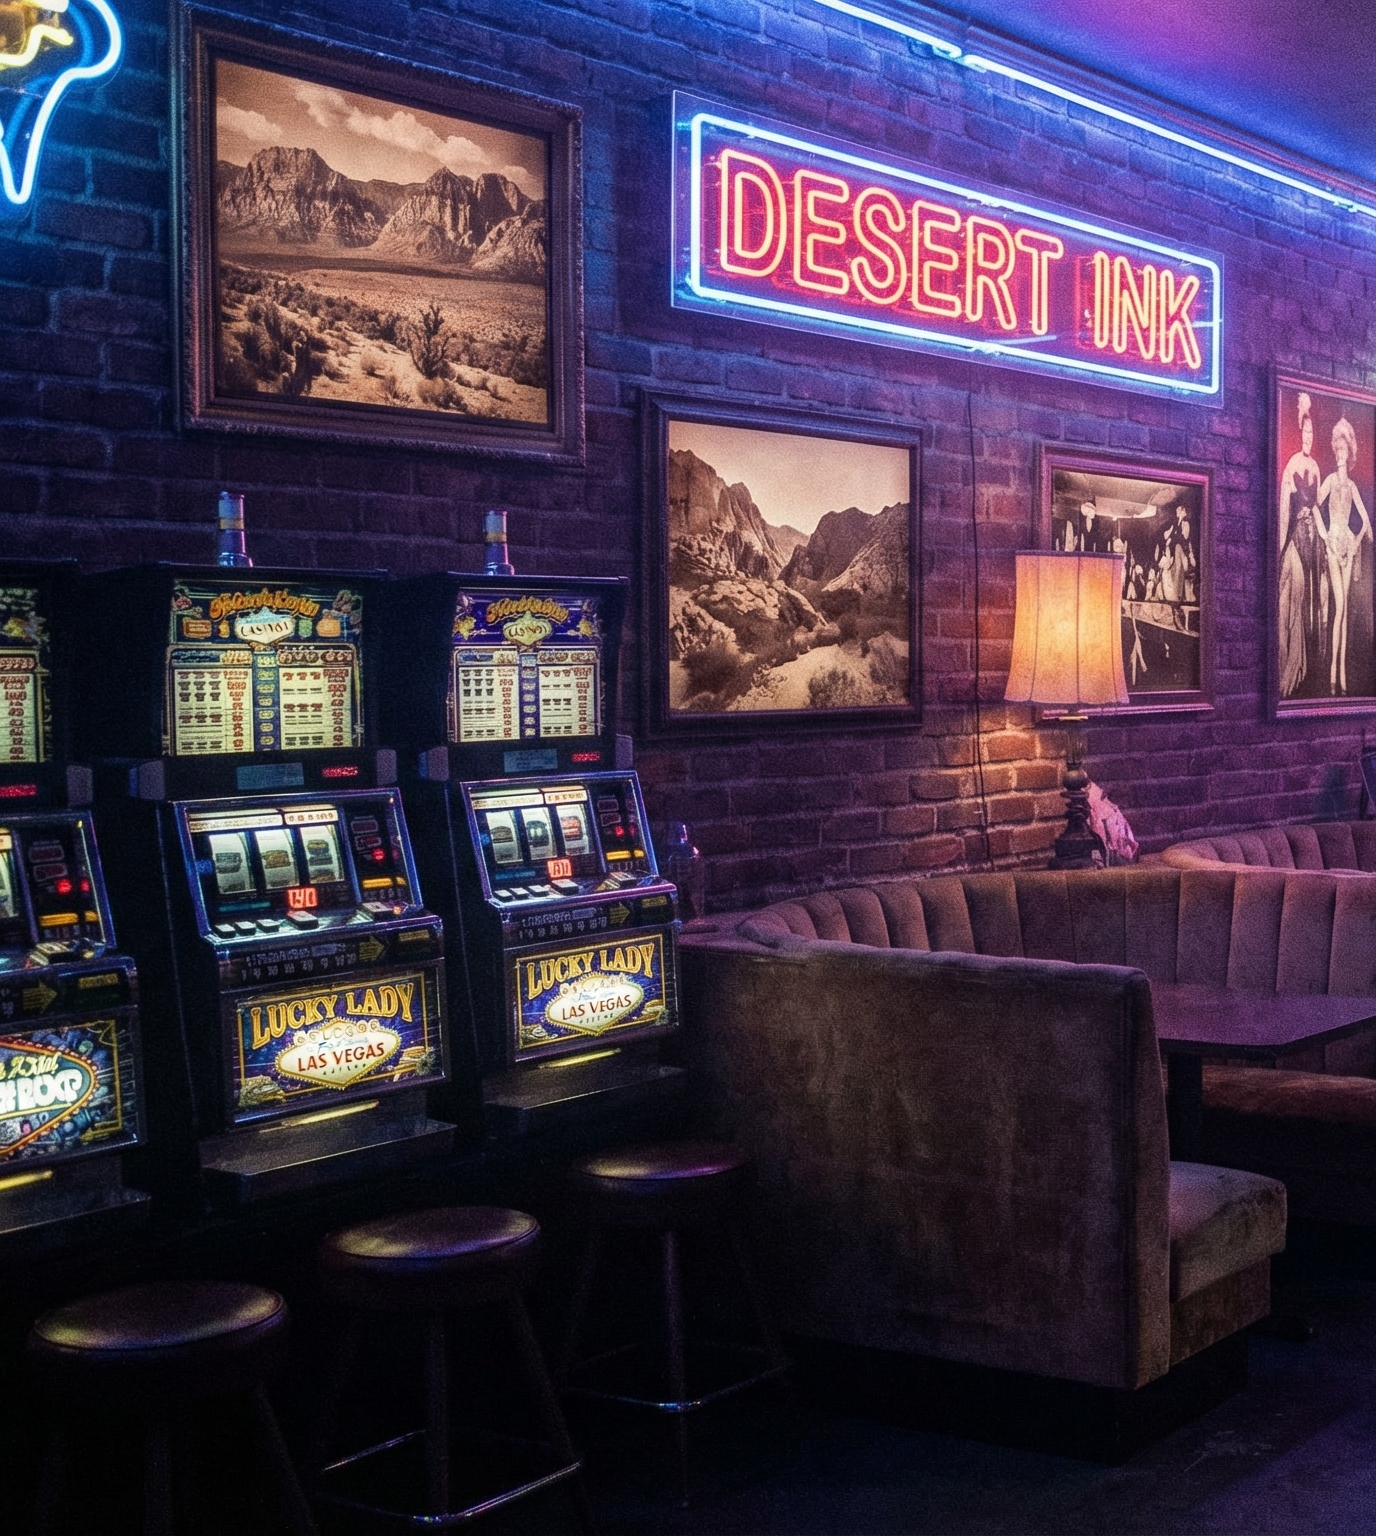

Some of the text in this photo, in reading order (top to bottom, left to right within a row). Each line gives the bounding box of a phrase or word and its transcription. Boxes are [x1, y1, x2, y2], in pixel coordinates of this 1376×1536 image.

[719, 148, 1202, 369] DESERT INK
[526, 942, 656, 1000] LUCKY LADY
[250, 982, 415, 1050] LUCKY LADY
[562, 1003, 586, 1021] LAS
[589, 994, 632, 1014] VEGAS
[297, 1053, 328, 1072] LAS
[333, 1042, 385, 1065] VEGAS
